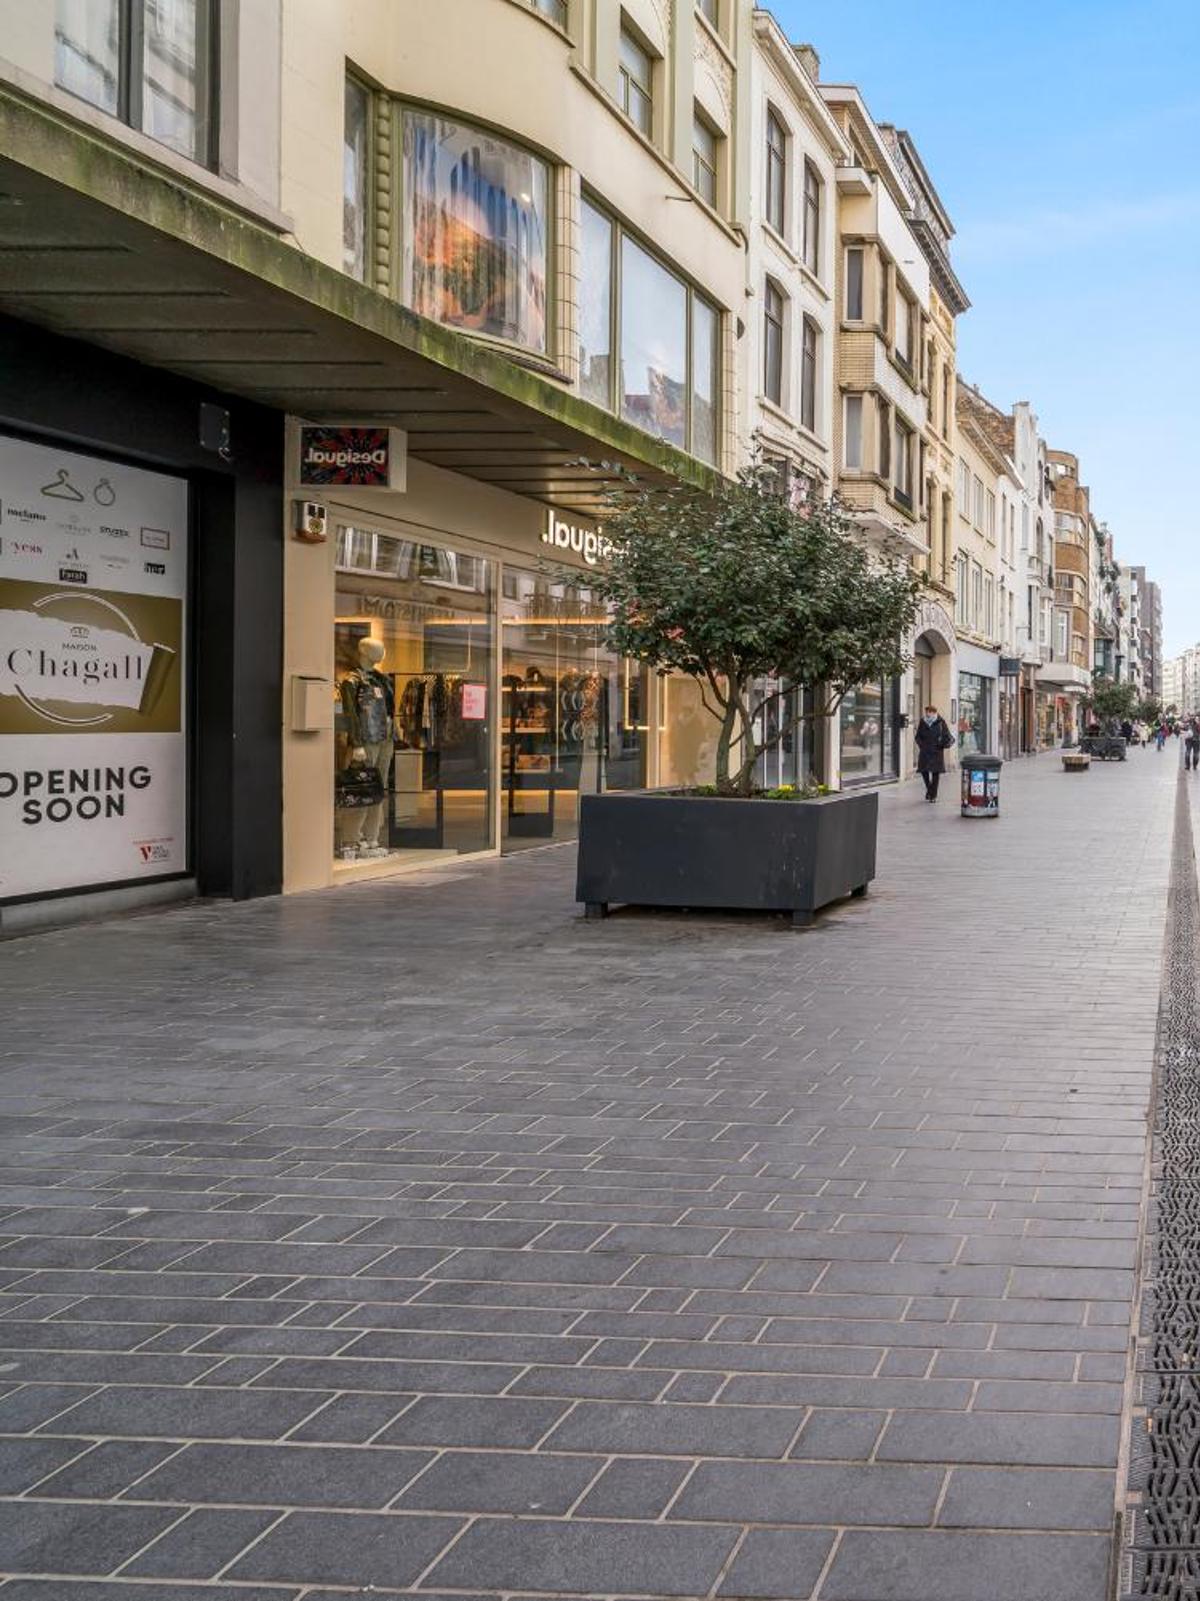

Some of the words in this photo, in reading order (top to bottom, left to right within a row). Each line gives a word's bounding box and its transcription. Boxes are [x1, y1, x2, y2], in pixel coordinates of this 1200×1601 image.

[7, 650, 143, 685] Chagall
[0, 765, 152, 798] OPENING
[22, 794, 125, 825] SOON
